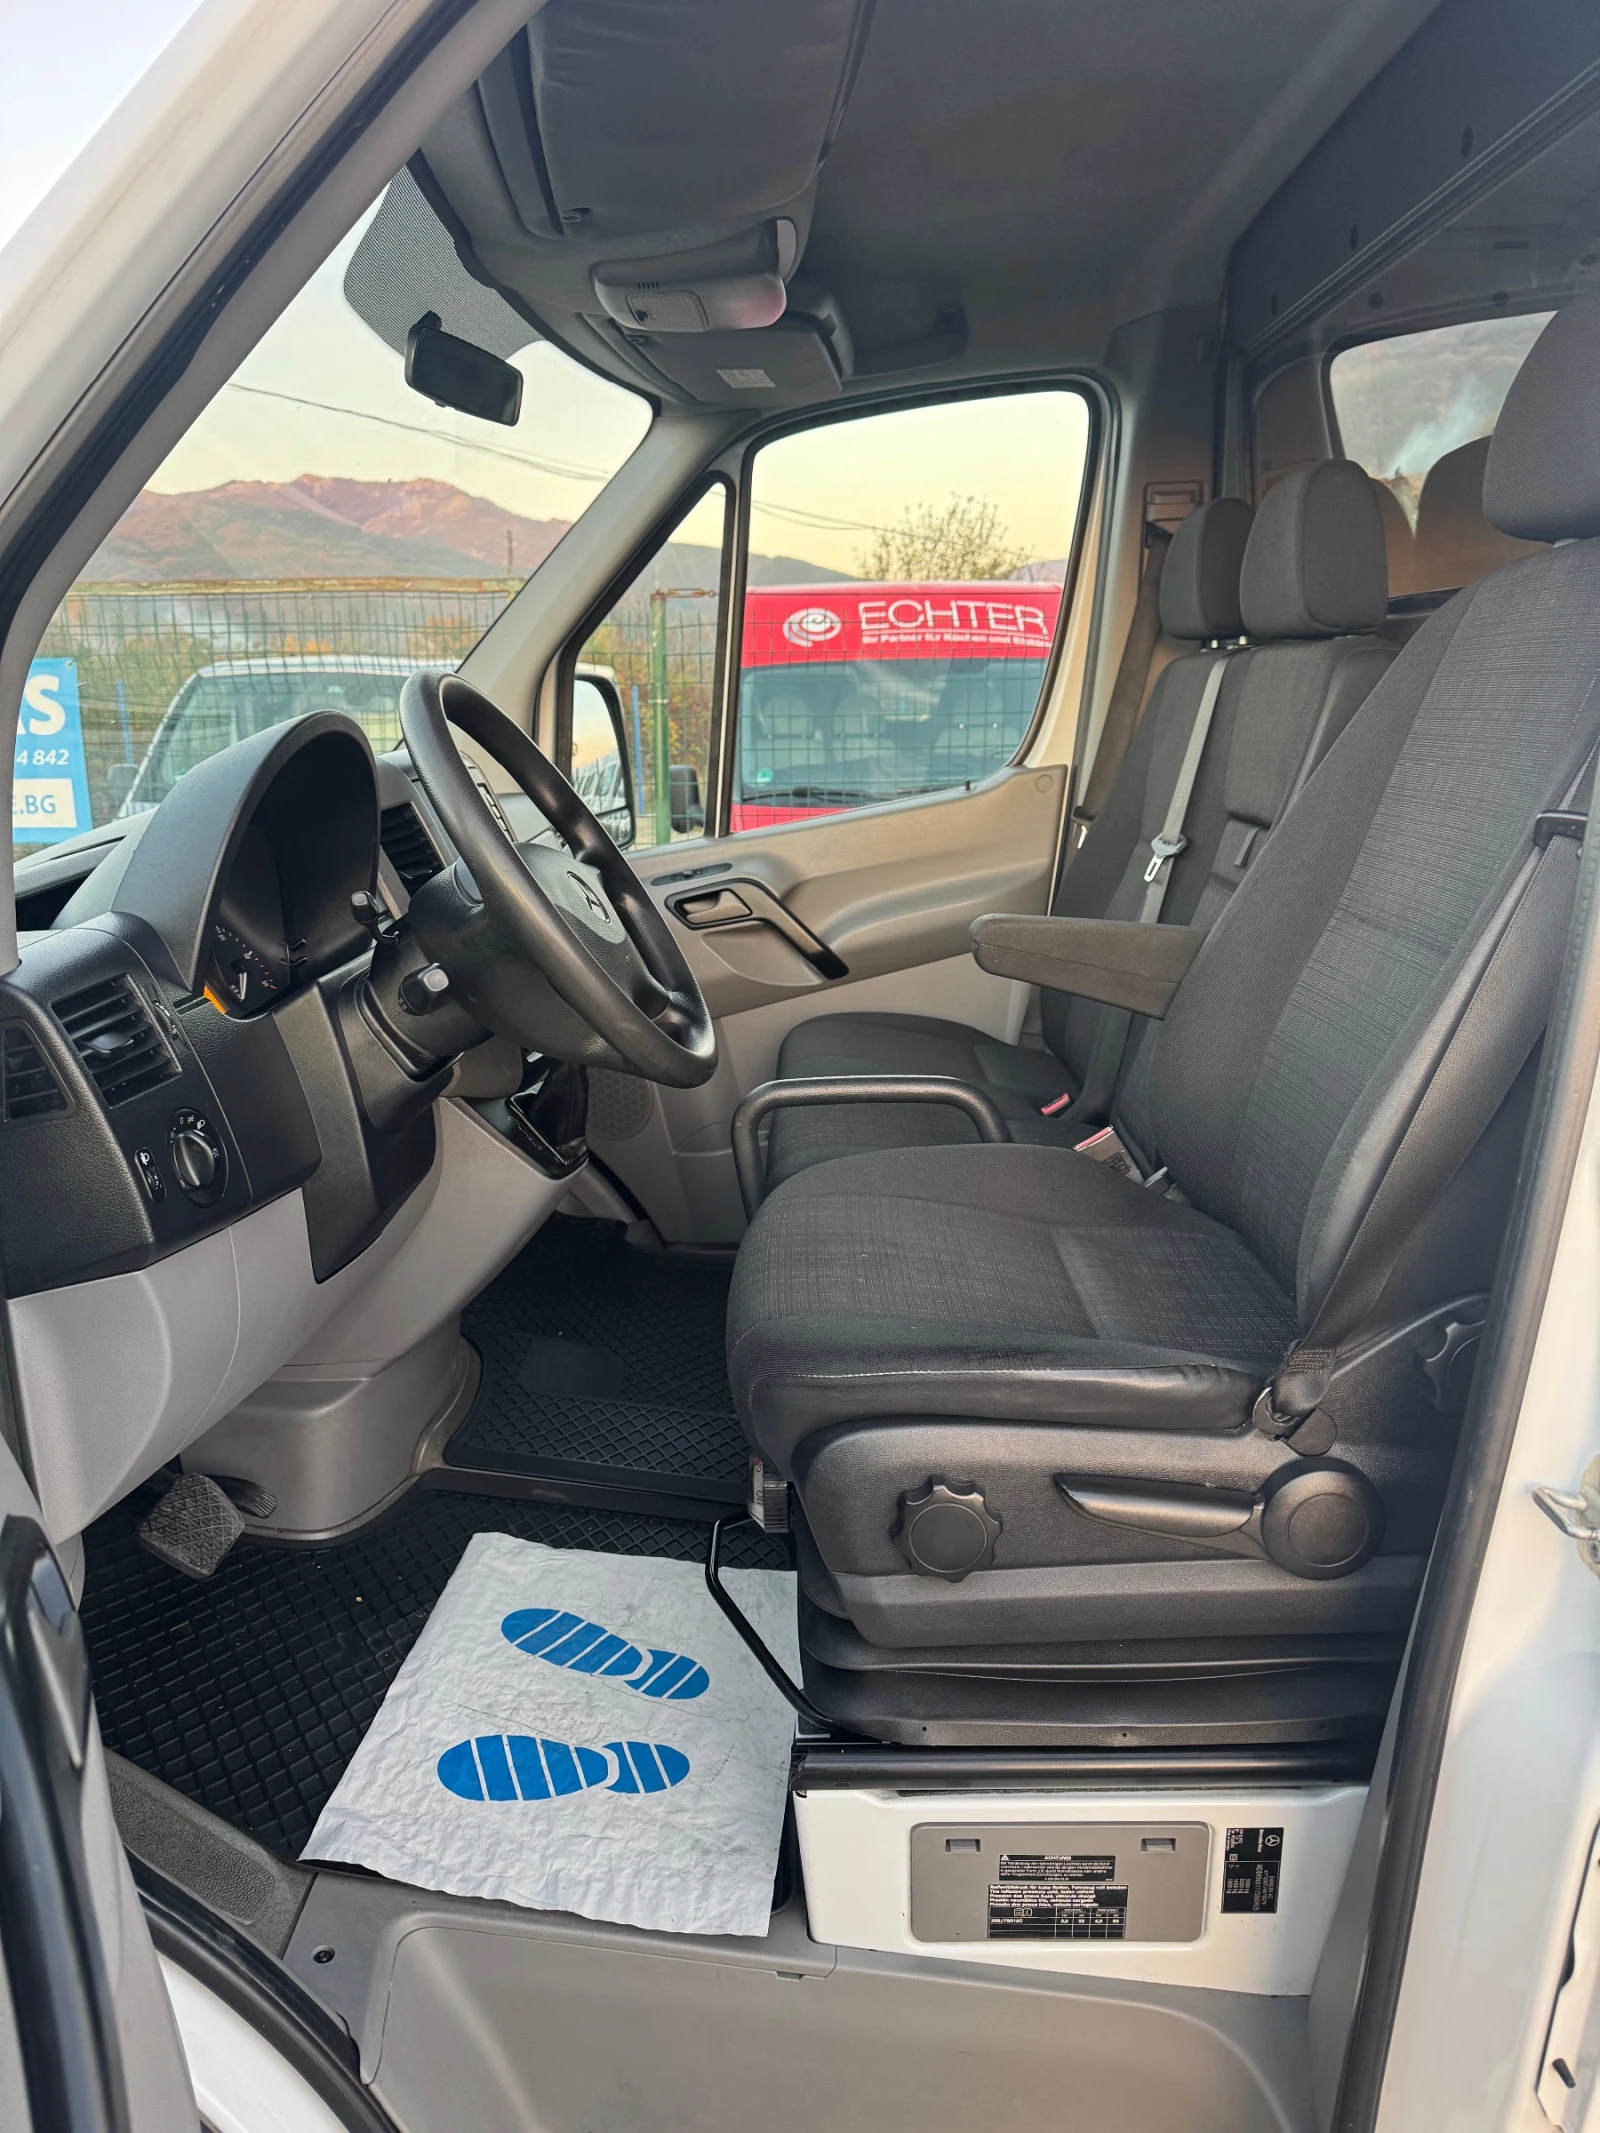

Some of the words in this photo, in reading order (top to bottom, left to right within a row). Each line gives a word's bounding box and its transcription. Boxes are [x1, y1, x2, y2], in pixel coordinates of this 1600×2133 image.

[858, 599, 1048, 635] ECHTER
[880, 633, 922, 643] Partner
[32, 749, 69, 766] 842
